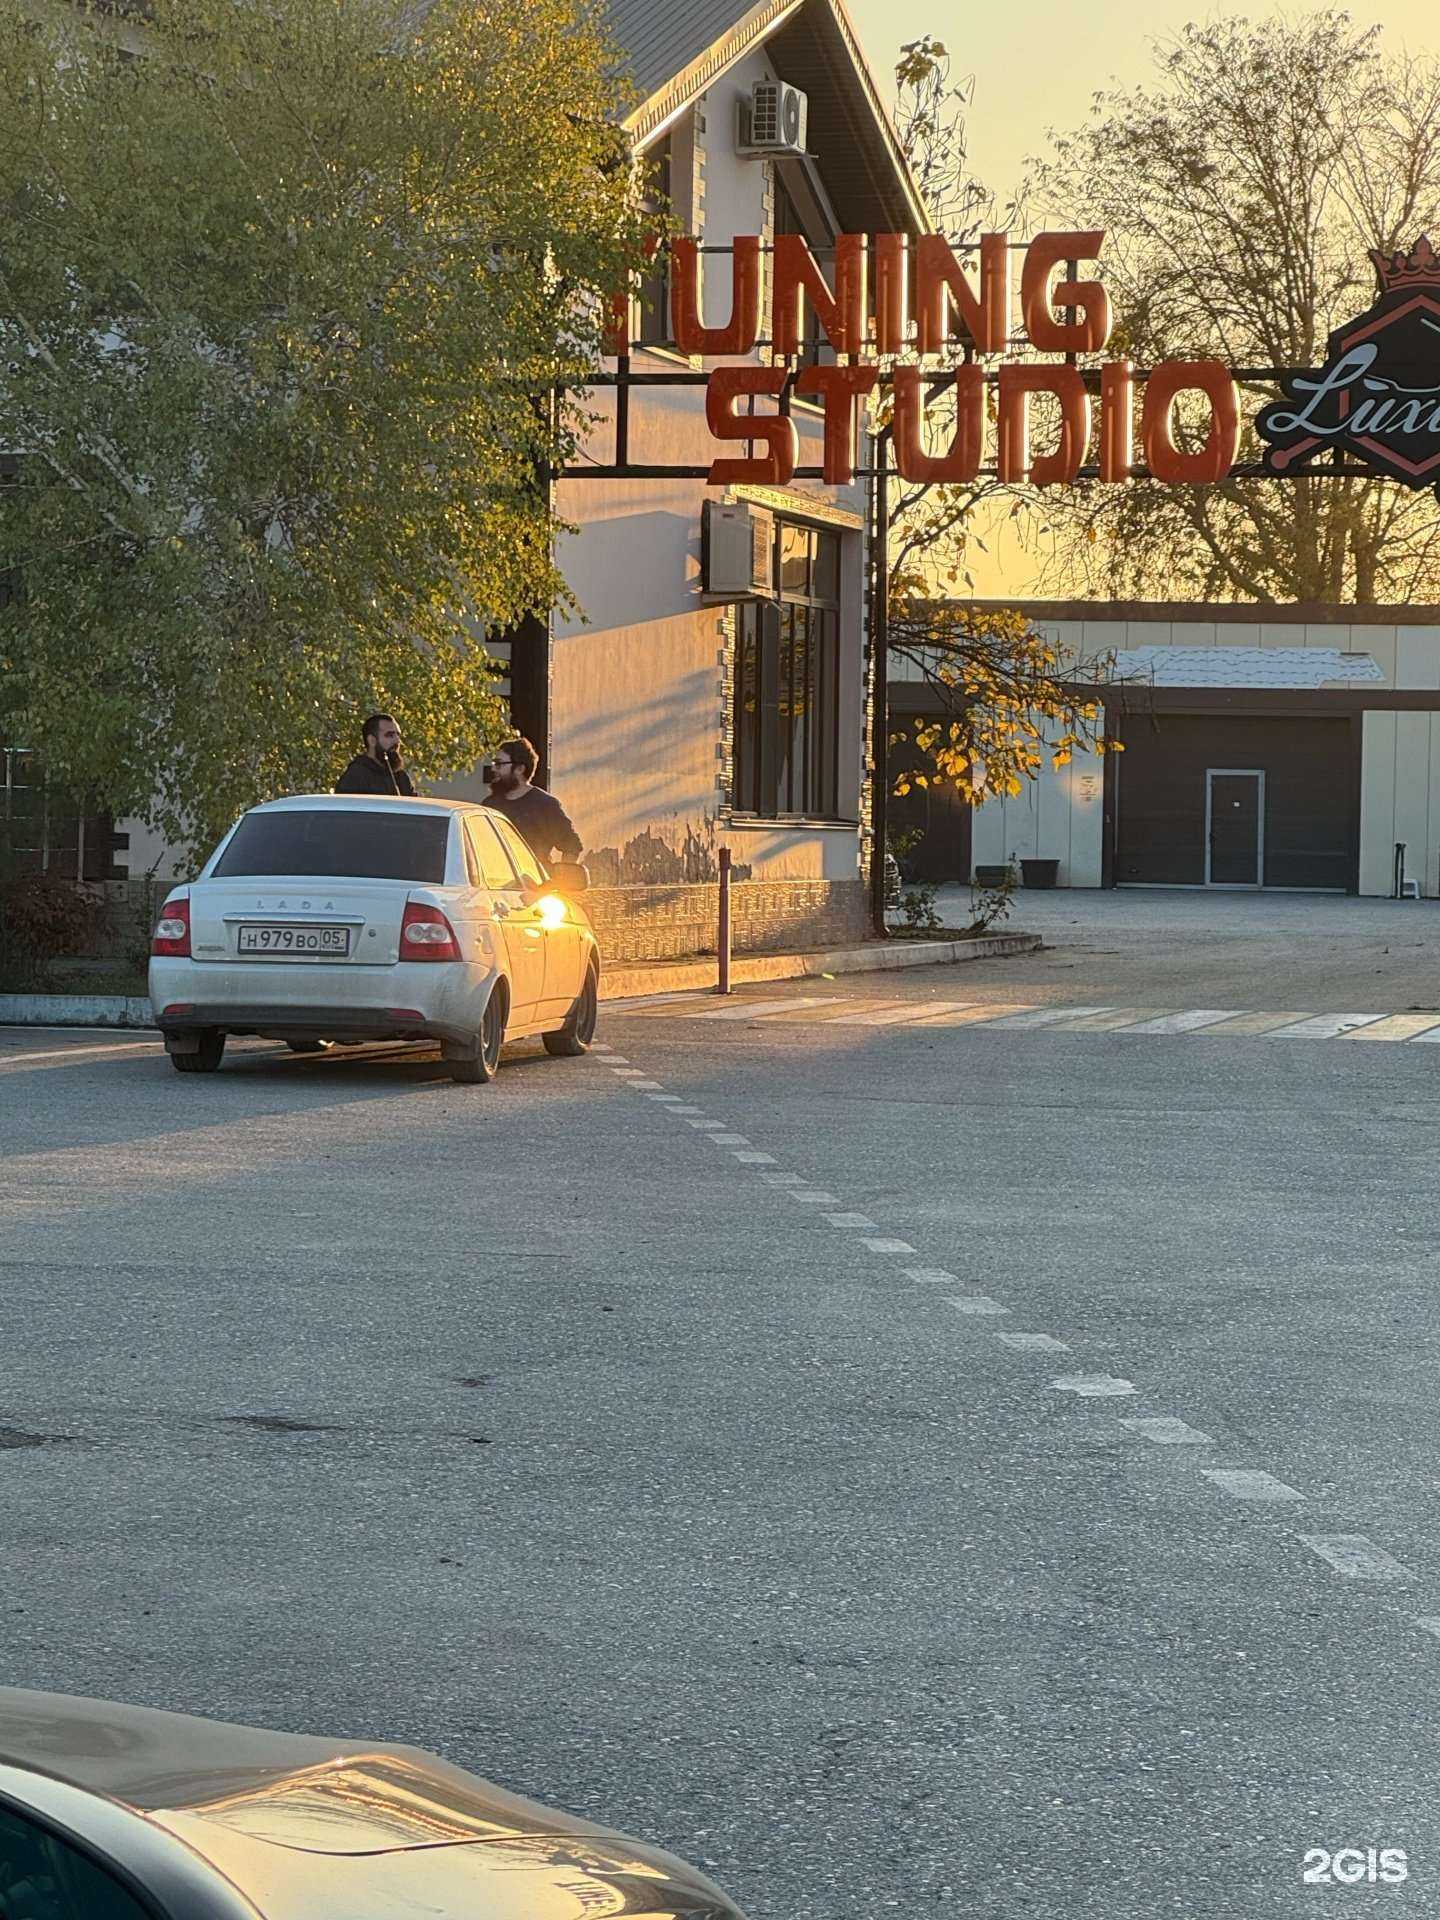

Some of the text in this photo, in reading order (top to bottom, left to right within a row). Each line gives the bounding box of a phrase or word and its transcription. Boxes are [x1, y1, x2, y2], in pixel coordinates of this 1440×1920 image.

[706, 360, 1239, 486] STUDIO
[256, 899, 335, 911] LADA
[322, 930, 341, 945] 05
